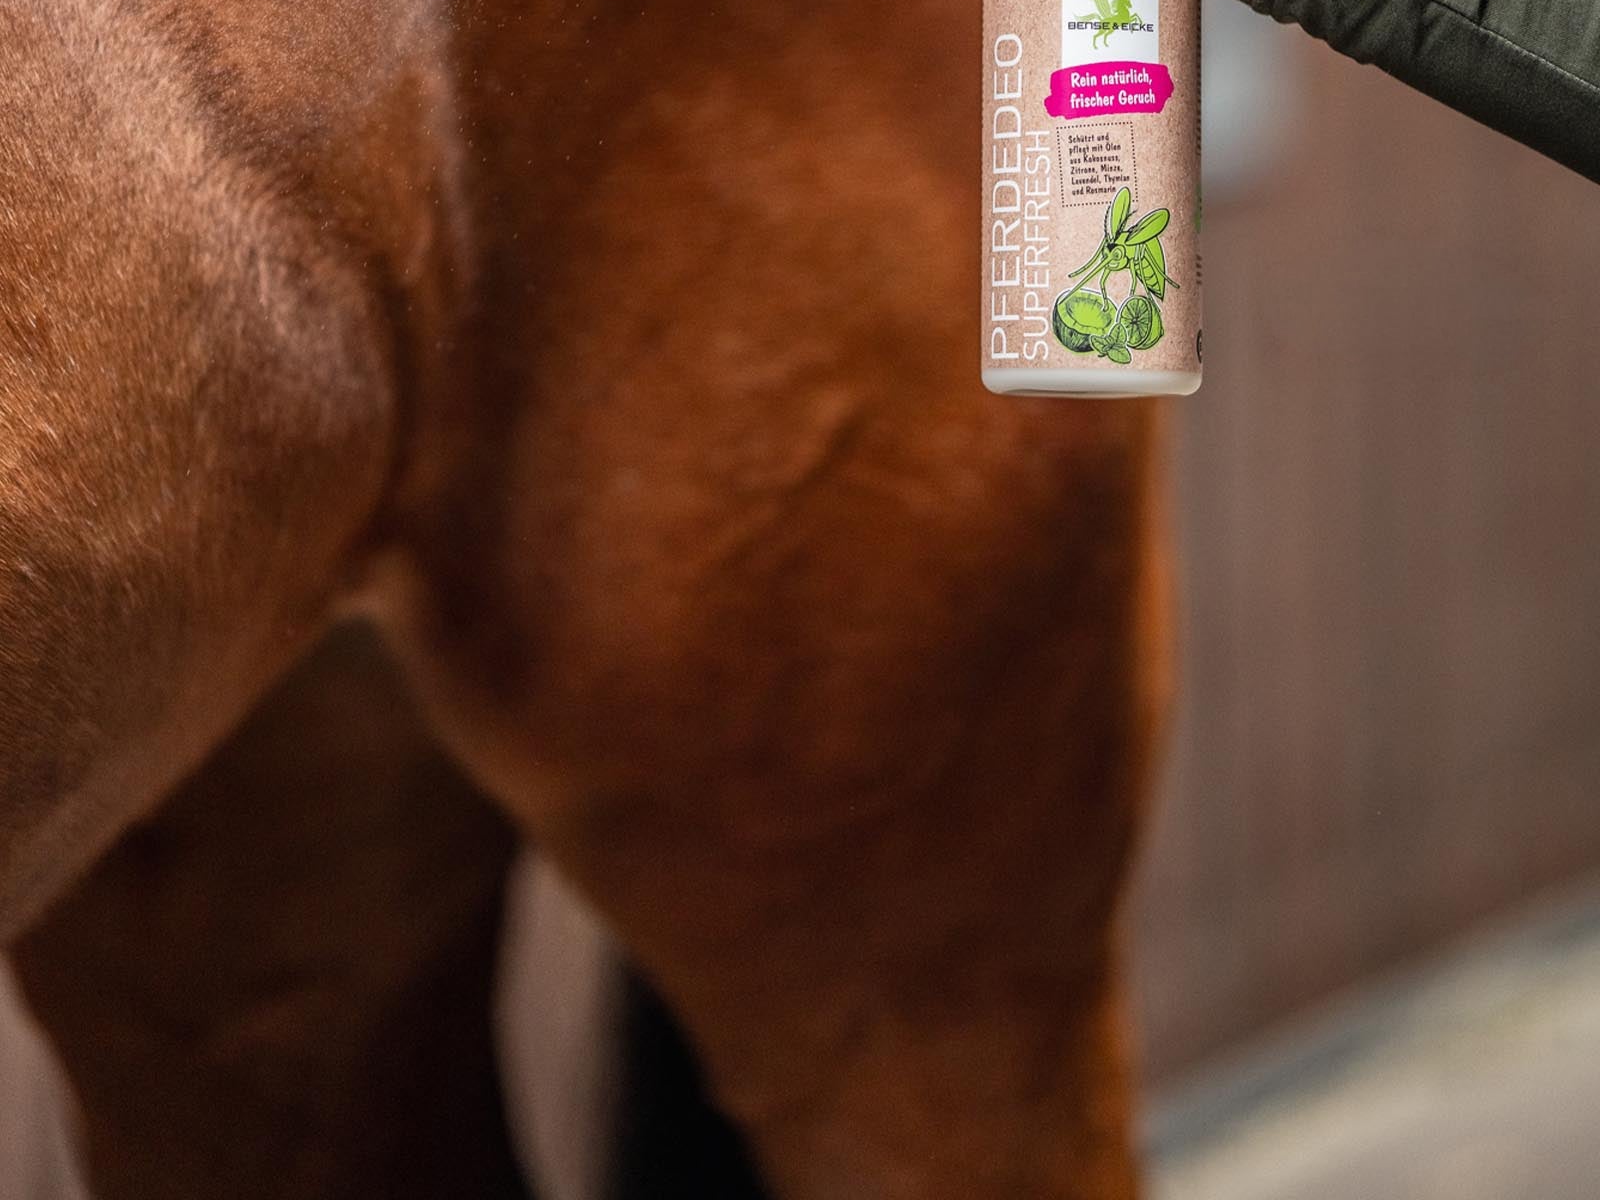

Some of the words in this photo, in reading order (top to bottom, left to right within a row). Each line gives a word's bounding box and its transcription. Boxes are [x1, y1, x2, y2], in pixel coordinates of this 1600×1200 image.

[1112, 22, 1120, 31] &
[1121, 22, 1154, 32] EICKE
[1070, 72, 1097, 88] Rein
[1101, 68, 1153, 85] natürlich,
[1070, 91, 1114, 109] frischer
[1118, 89, 1155, 105] Geruch
[1068, 135, 1095, 144] Schützt
[1097, 133, 1110, 141] und
[1069, 145, 1089, 156] pflegt
[1092, 144, 1103, 152] mit
[1105, 142, 1121, 151] Ölen
[1083, 154, 1120, 163] Kokosnuss,
[1071, 166, 1098, 175] Zitrone,
[1101, 164, 1123, 172] Minze,
[1071, 175, 1101, 185] Lavendel,
[1104, 174, 1130, 184] Thymian
[1072, 187, 1084, 195] und
[1086, 185, 1116, 194] Rosmarin
[991, 33, 1023, 361] PFERDEDEO
[1023, 130, 1051, 361] SUPERFRESH
